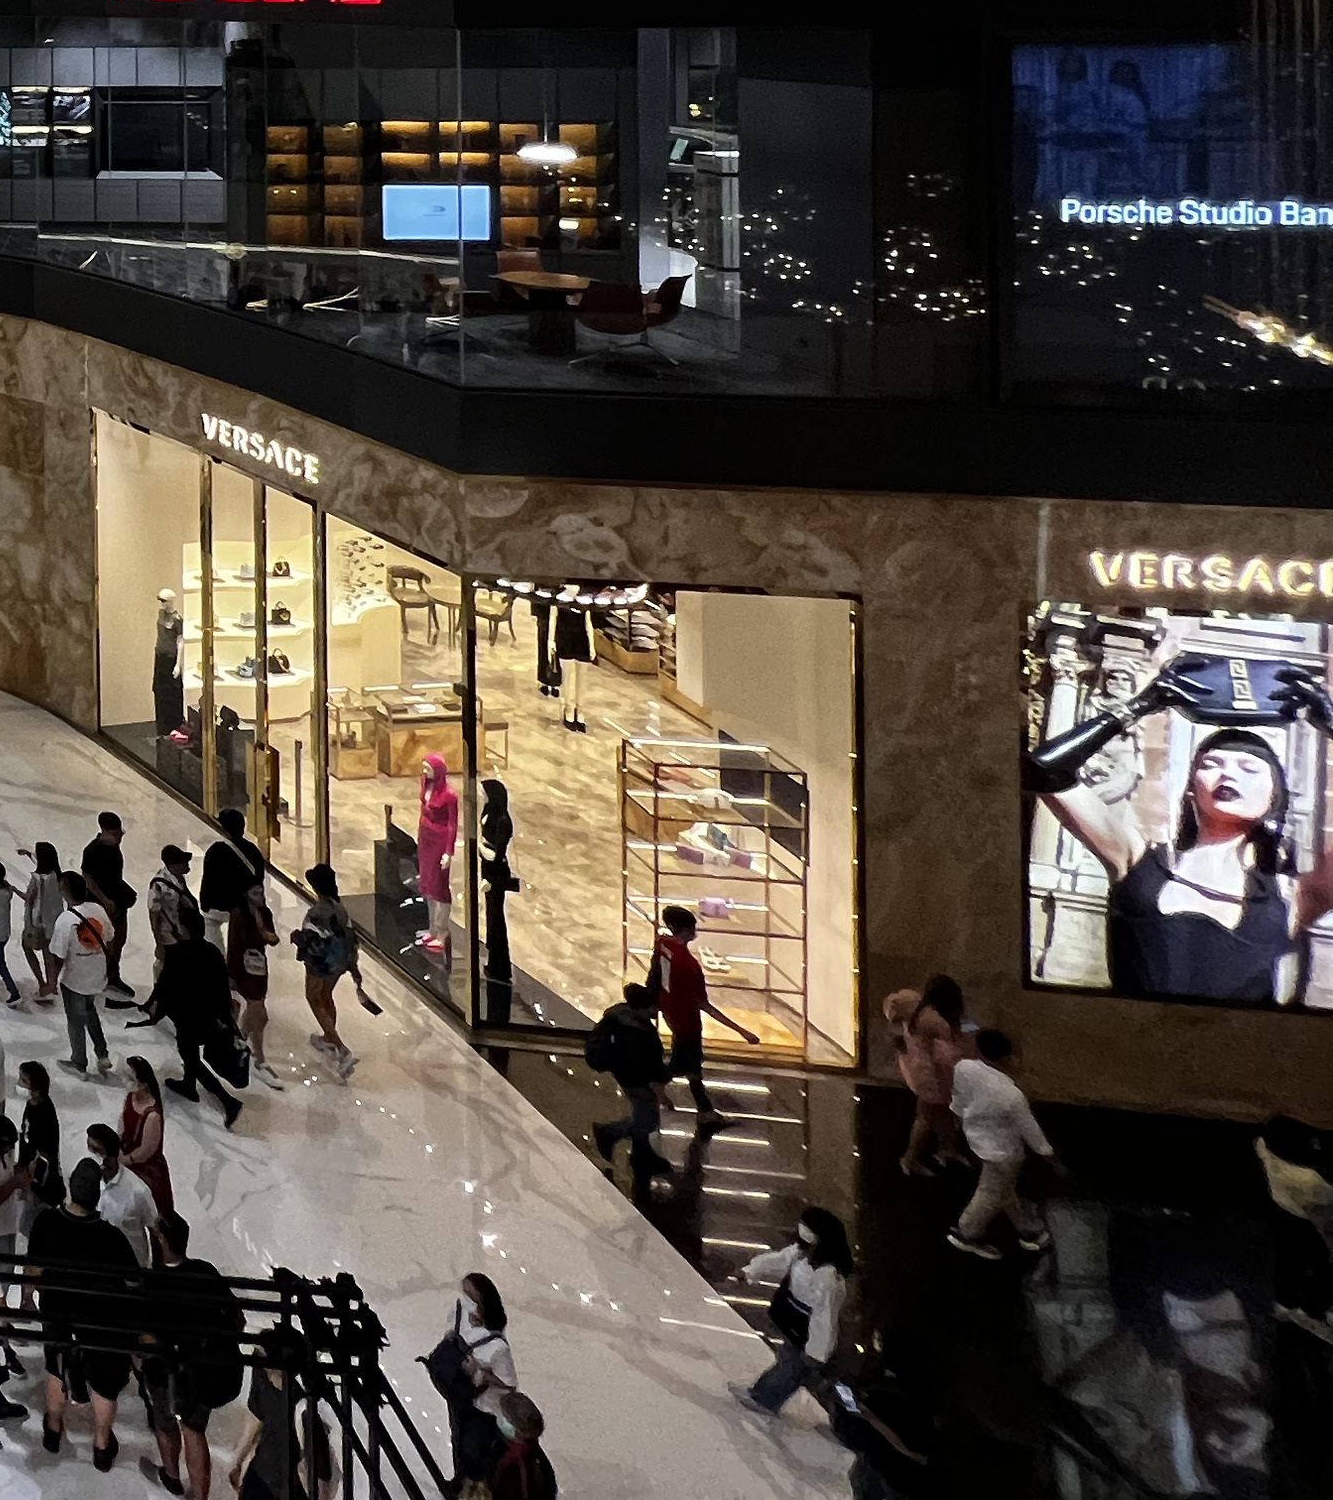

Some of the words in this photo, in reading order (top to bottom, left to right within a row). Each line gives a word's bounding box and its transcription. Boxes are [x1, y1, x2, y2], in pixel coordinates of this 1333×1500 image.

[1061, 198, 1173, 225] Porsche
[1179, 198, 1273, 226] Studio
[201, 413, 319, 484] VERSACE
